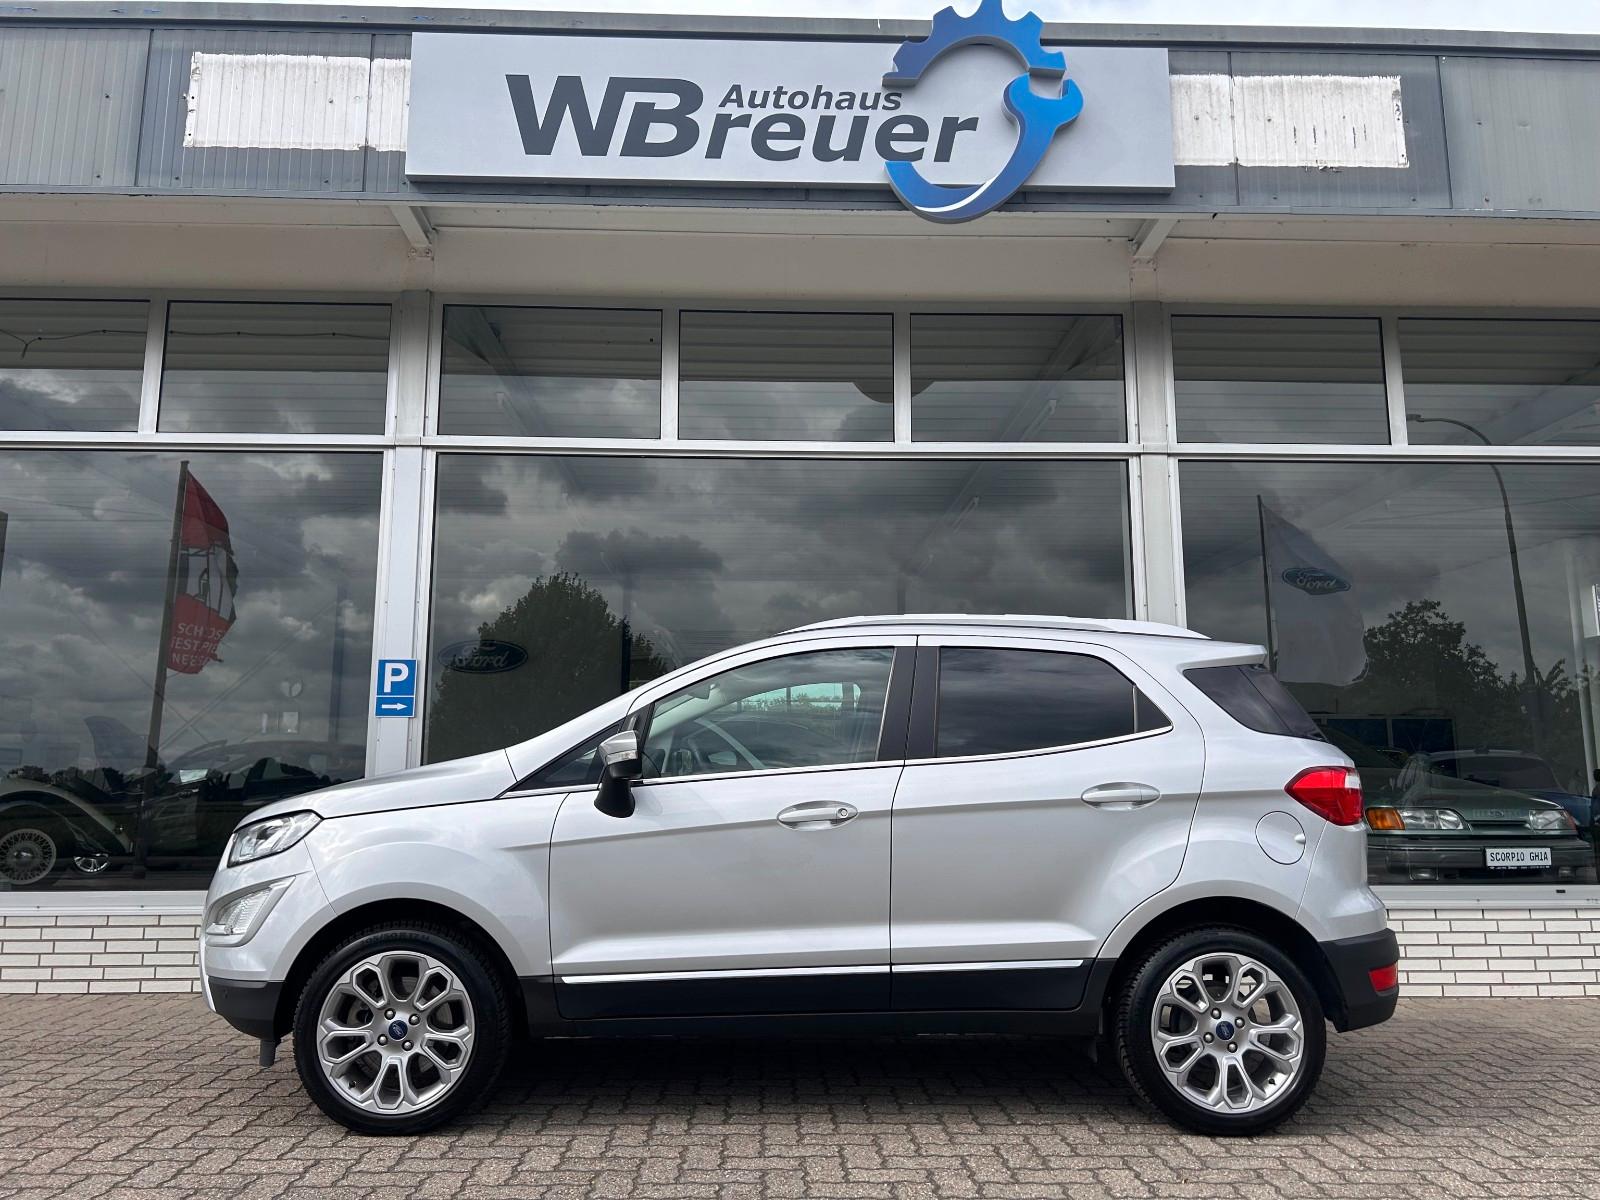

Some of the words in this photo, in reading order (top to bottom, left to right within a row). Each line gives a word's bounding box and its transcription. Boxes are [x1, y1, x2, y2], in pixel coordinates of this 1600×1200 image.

[718, 83, 902, 111] Autohaus
[1296, 570, 1337, 589] Ford
[453, 645, 509, 668] Ford
[383, 662, 409, 693] P
[1490, 852, 1525, 861] SCORPIO
[1529, 851, 1548, 861] GHIA
